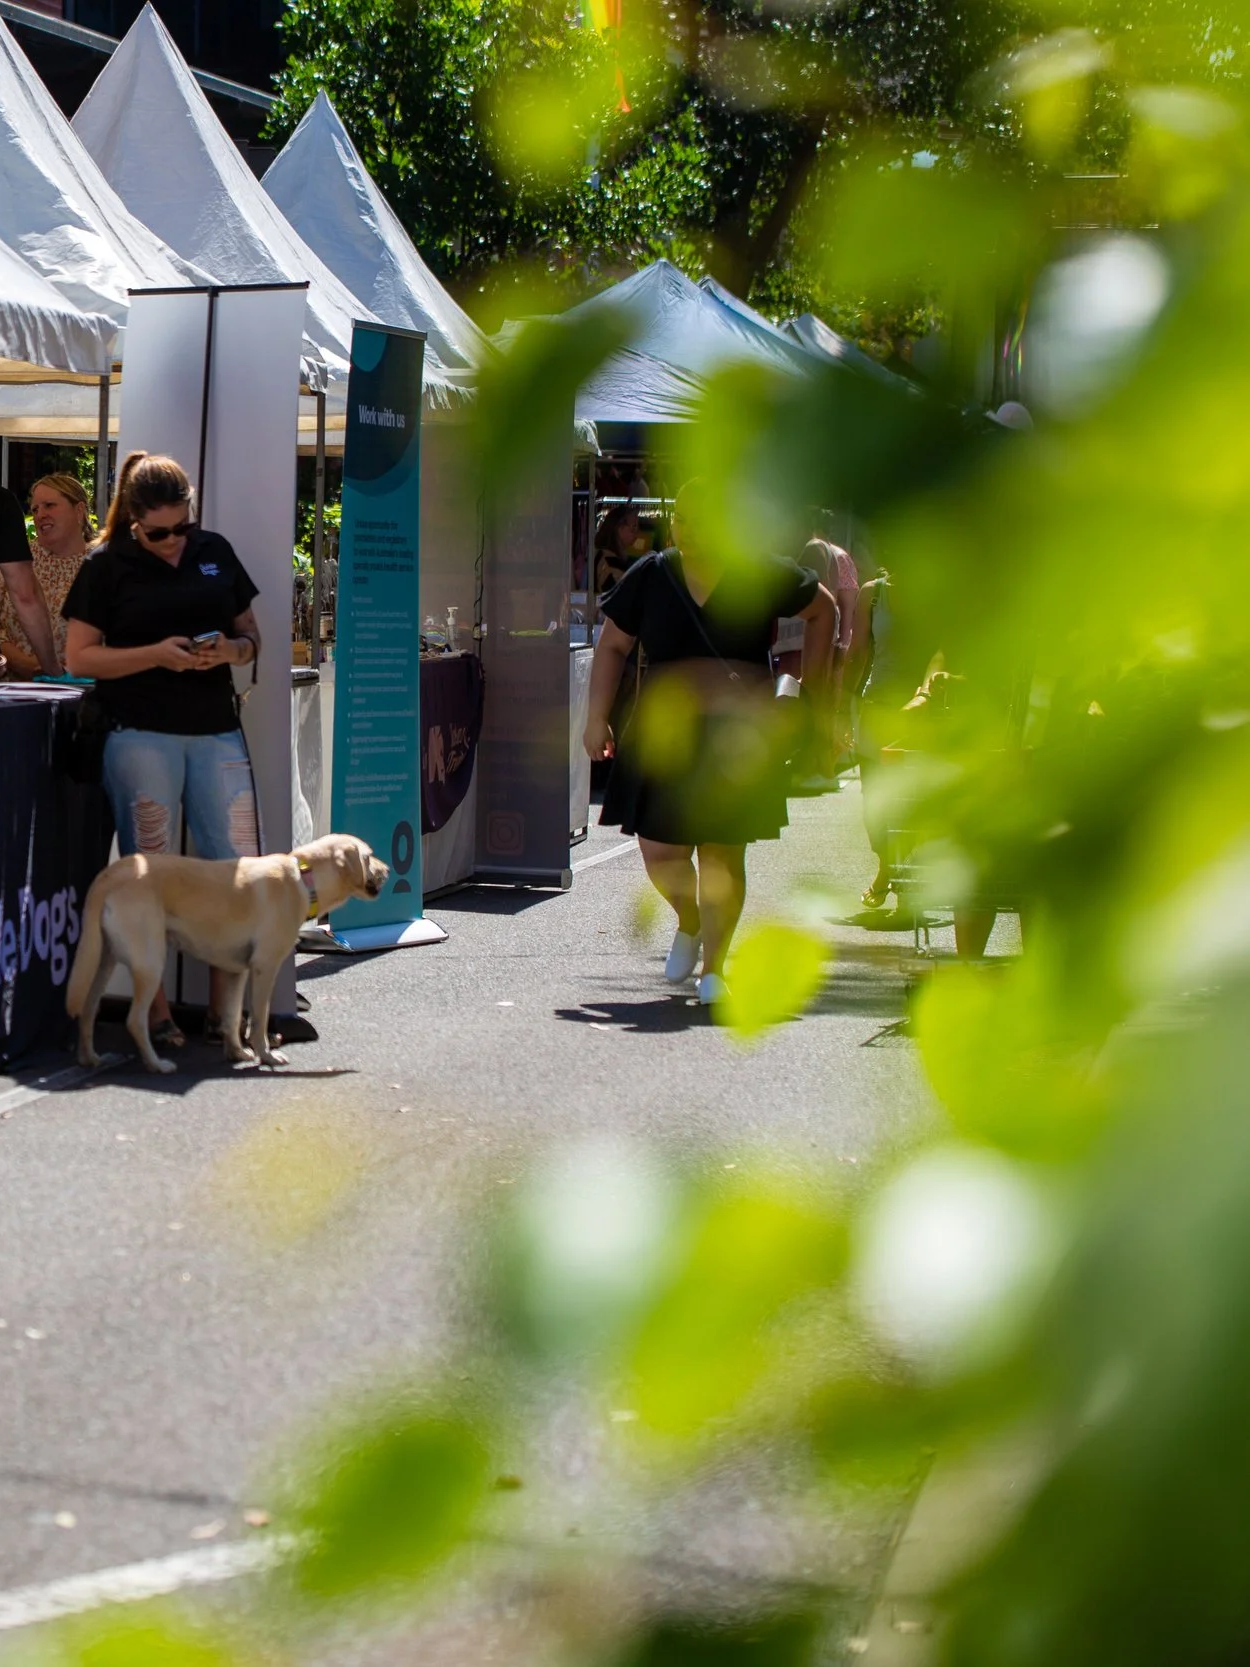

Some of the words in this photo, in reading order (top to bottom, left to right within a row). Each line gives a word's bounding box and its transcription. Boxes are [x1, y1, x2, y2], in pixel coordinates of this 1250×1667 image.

[358, 405, 376, 425] Work
[377, 408, 395, 427] with
[396, 413, 406, 428] us
[18, 885, 80, 986] Dogs
